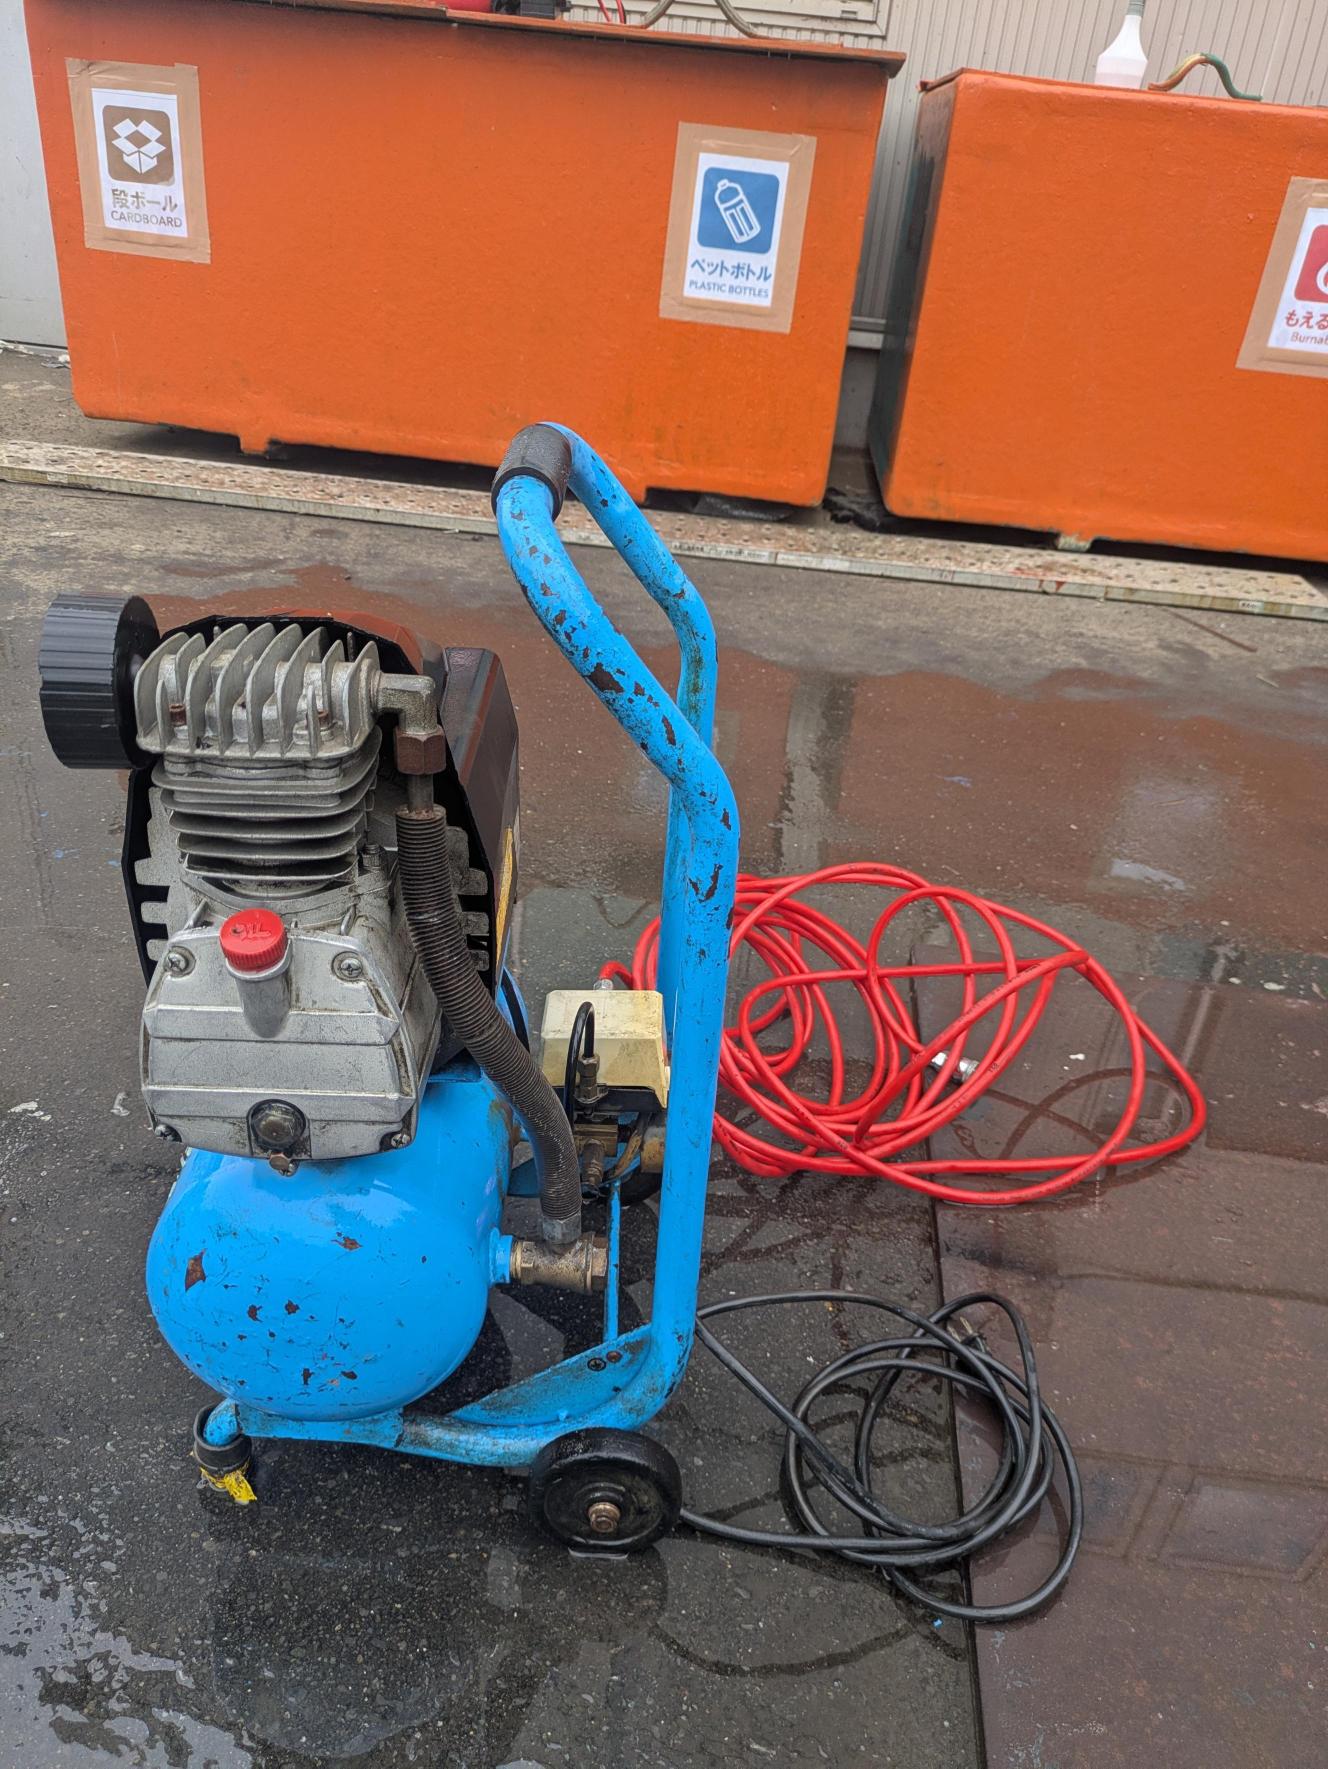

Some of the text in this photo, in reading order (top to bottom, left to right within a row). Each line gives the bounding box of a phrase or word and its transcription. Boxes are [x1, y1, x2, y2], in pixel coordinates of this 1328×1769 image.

[111, 188, 178, 213] 段ボール
[111, 210, 182, 228] CARDBOARD
[691, 258, 772, 282] ペットボトル
[689, 279, 769, 298] PLASTIC BOTTLES
[1285, 309, 1328, 330] もえる
